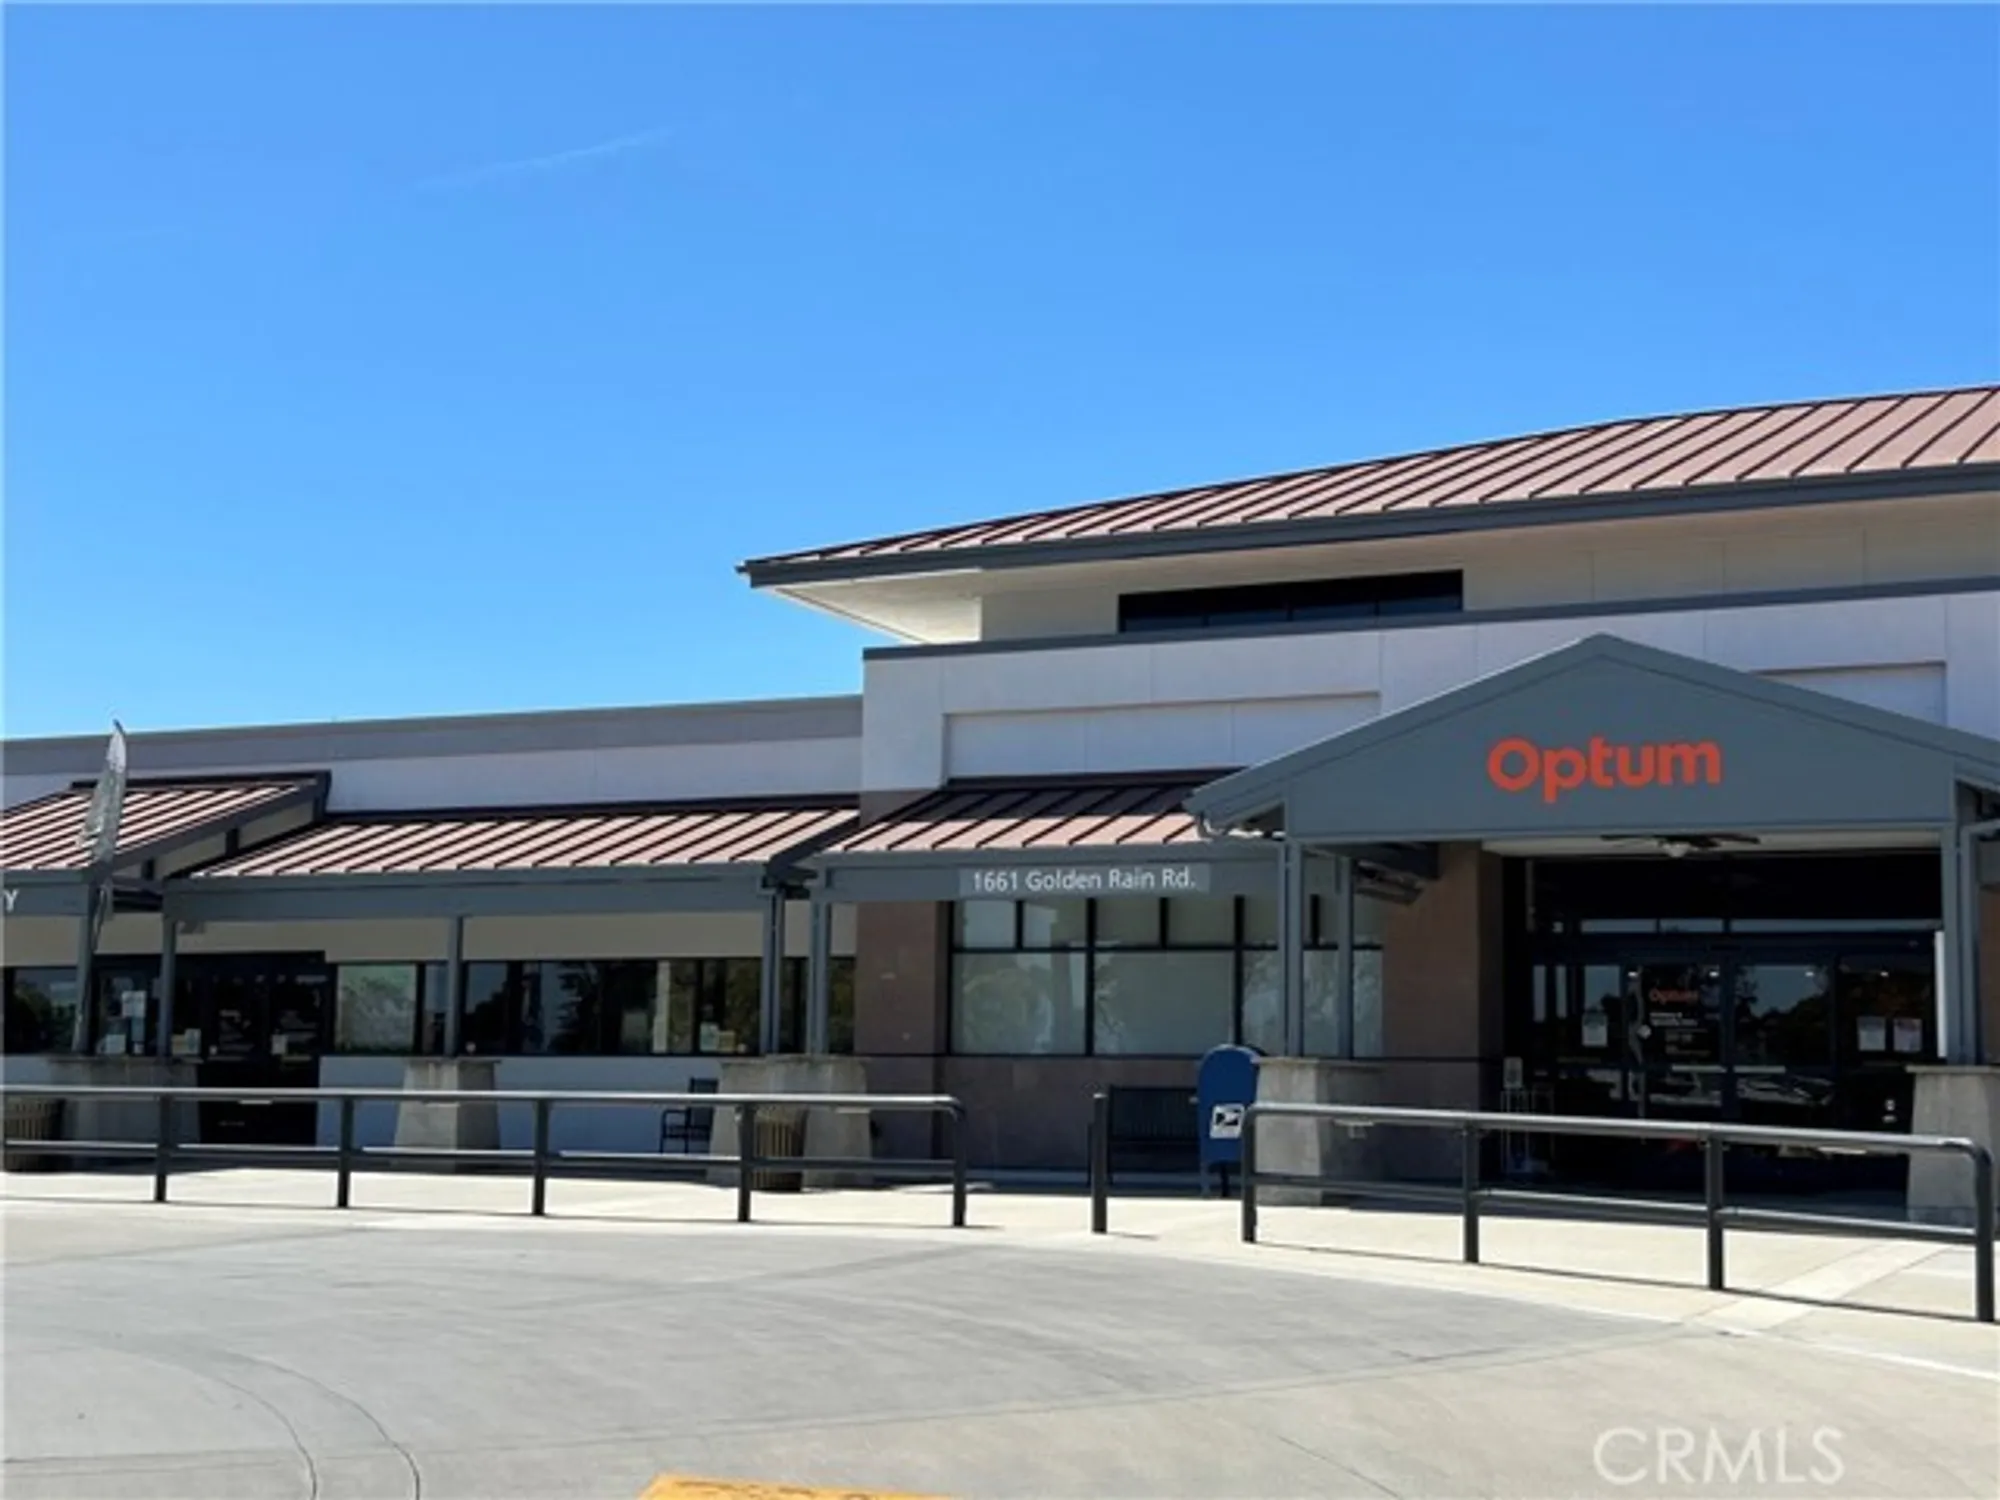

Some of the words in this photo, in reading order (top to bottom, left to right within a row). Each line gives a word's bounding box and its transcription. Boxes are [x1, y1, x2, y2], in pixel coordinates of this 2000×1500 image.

[1487, 735, 1721, 804] Optum
[973, 871, 1017, 892] 1661
[1025, 869, 1101, 890] Golden
[1108, 867, 1155, 888] Rain
[1162, 866, 1196, 887] Rd.
